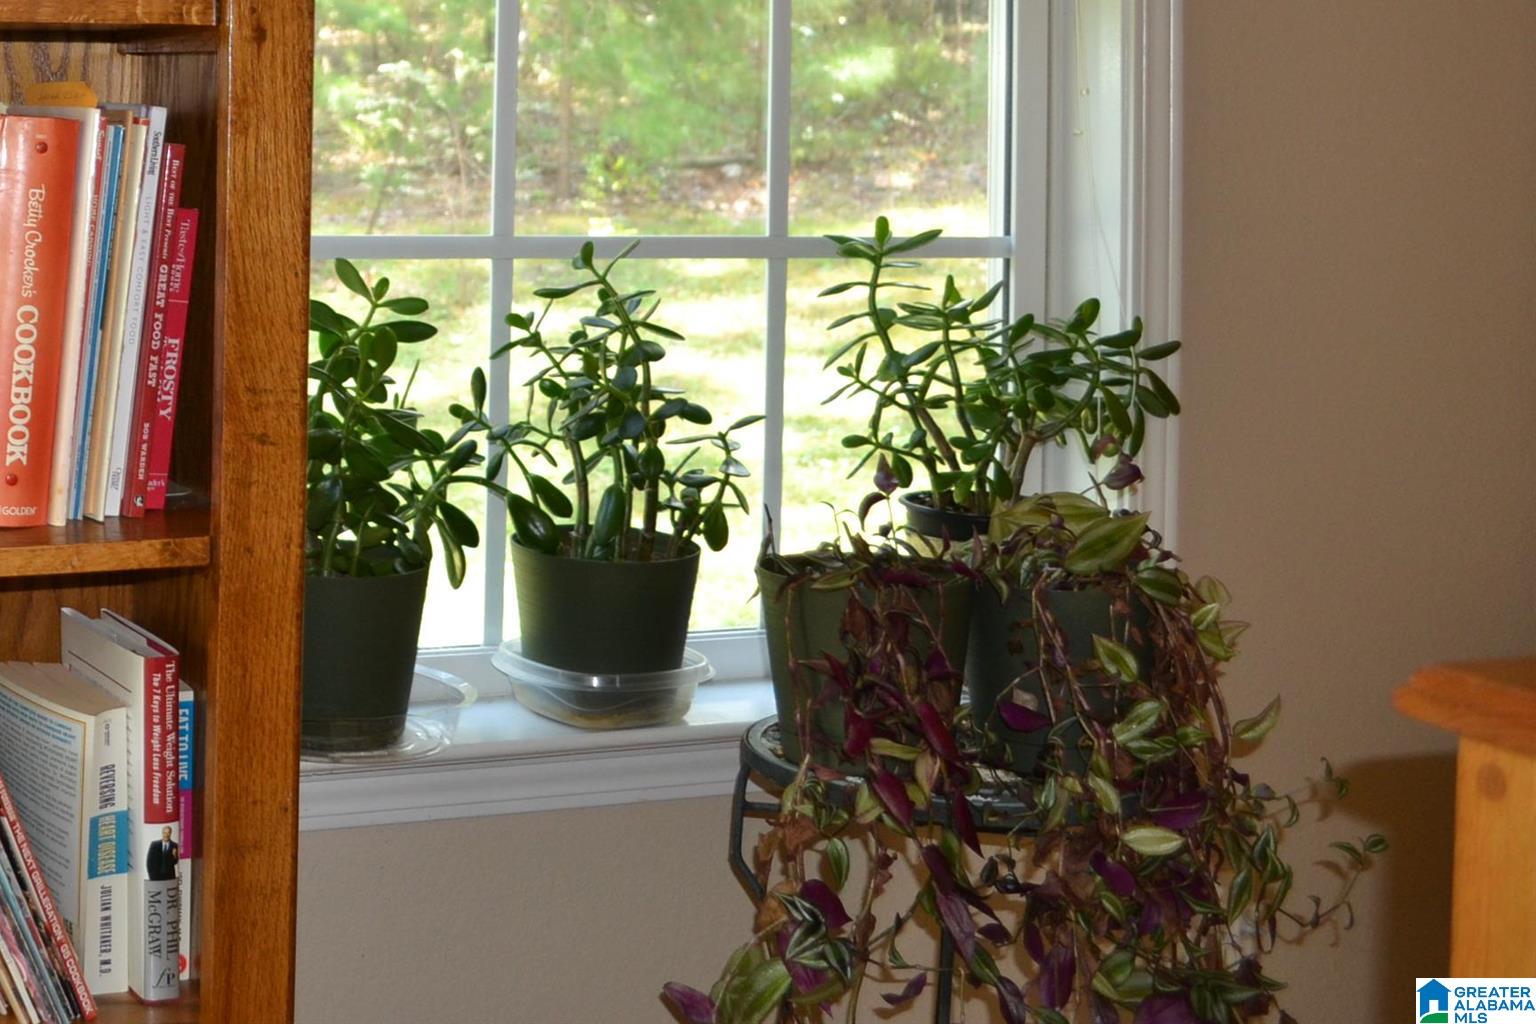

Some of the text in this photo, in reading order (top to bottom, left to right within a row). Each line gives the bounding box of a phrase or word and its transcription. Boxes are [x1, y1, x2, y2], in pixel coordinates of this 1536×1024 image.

[147, 130, 163, 176] Southern Living
[170, 159, 180, 178] BEST
[165, 208, 175, 228] BEST
[162, 229, 172, 260] Presents
[128, 196, 152, 345] LIGHT EASY COMFORT FOOD
[154, 264, 168, 308] GREAT
[4, 184, 46, 466] Betty Crocker's COOKBOOK
[151, 312, 163, 350] FOOD
[147, 355, 158, 387] FAST
[159, 336, 180, 422] FROSTY
[137, 422, 150, 480] BOB WARDEN
[152, 673, 162, 687] The
[151, 694, 161, 712] Keys
[178, 708, 189, 730] EAT
[151, 723, 161, 750] Weight
[163, 660, 178, 813] The Ultimate Weight Solution
[151, 751, 161, 771] Loss
[98, 764, 117, 810] REVERSING
[152, 772, 161, 805] Freedom
[100, 885, 112, 912] JULIAN
[12, 823, 93, 1016] THE NEXT COOKBOOK
[147, 890, 162, 959] McGRAW
[166, 887, 178, 961] DR. PHIL
